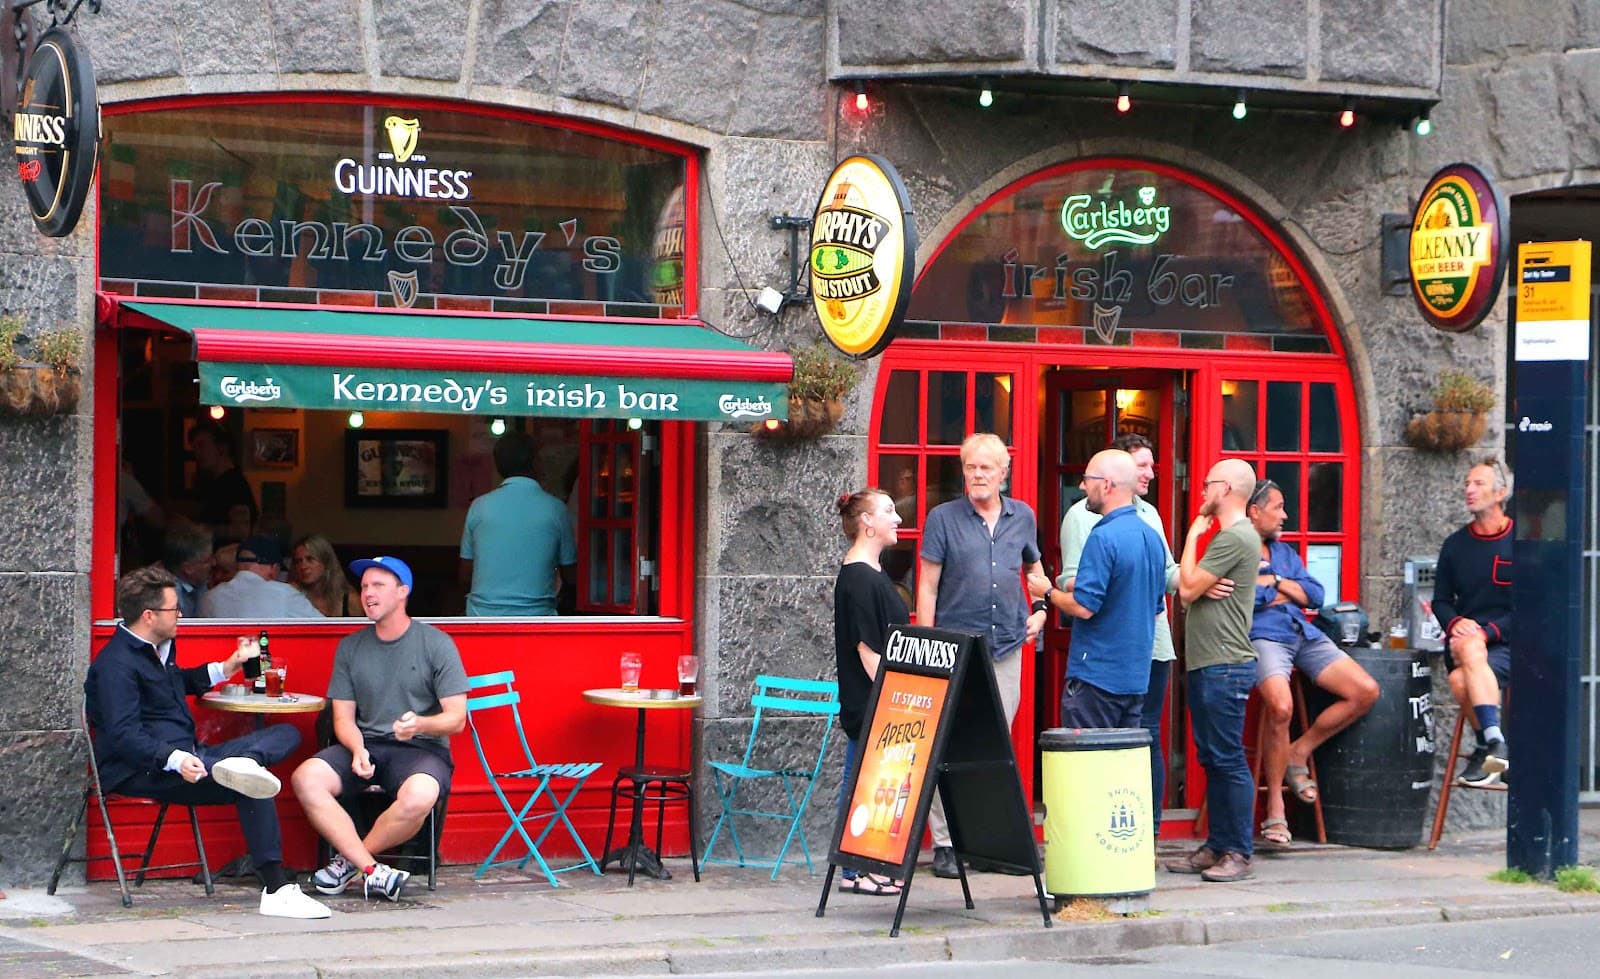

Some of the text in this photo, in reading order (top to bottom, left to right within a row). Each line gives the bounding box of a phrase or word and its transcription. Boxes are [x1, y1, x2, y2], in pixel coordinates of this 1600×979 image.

[334, 158, 470, 200] GUINNESS
[171, 179, 621, 290] Kennedy's
[1061, 192, 1171, 248] Carlsberg
[1001, 248, 1235, 309] irish bar
[1438, 261, 1464, 273] BEER
[829, 273, 873, 298] STOUT
[1523, 285, 1534, 298] 31
[221, 377, 281, 402] Carlsberg
[333, 374, 680, 412] Kennedy's irish bar
[718, 394, 773, 418] Carlsberg
[886, 630, 958, 670] GUINNESS
[891, 691, 933, 710] IT STARTS
[876, 720, 927, 750] APEROL
